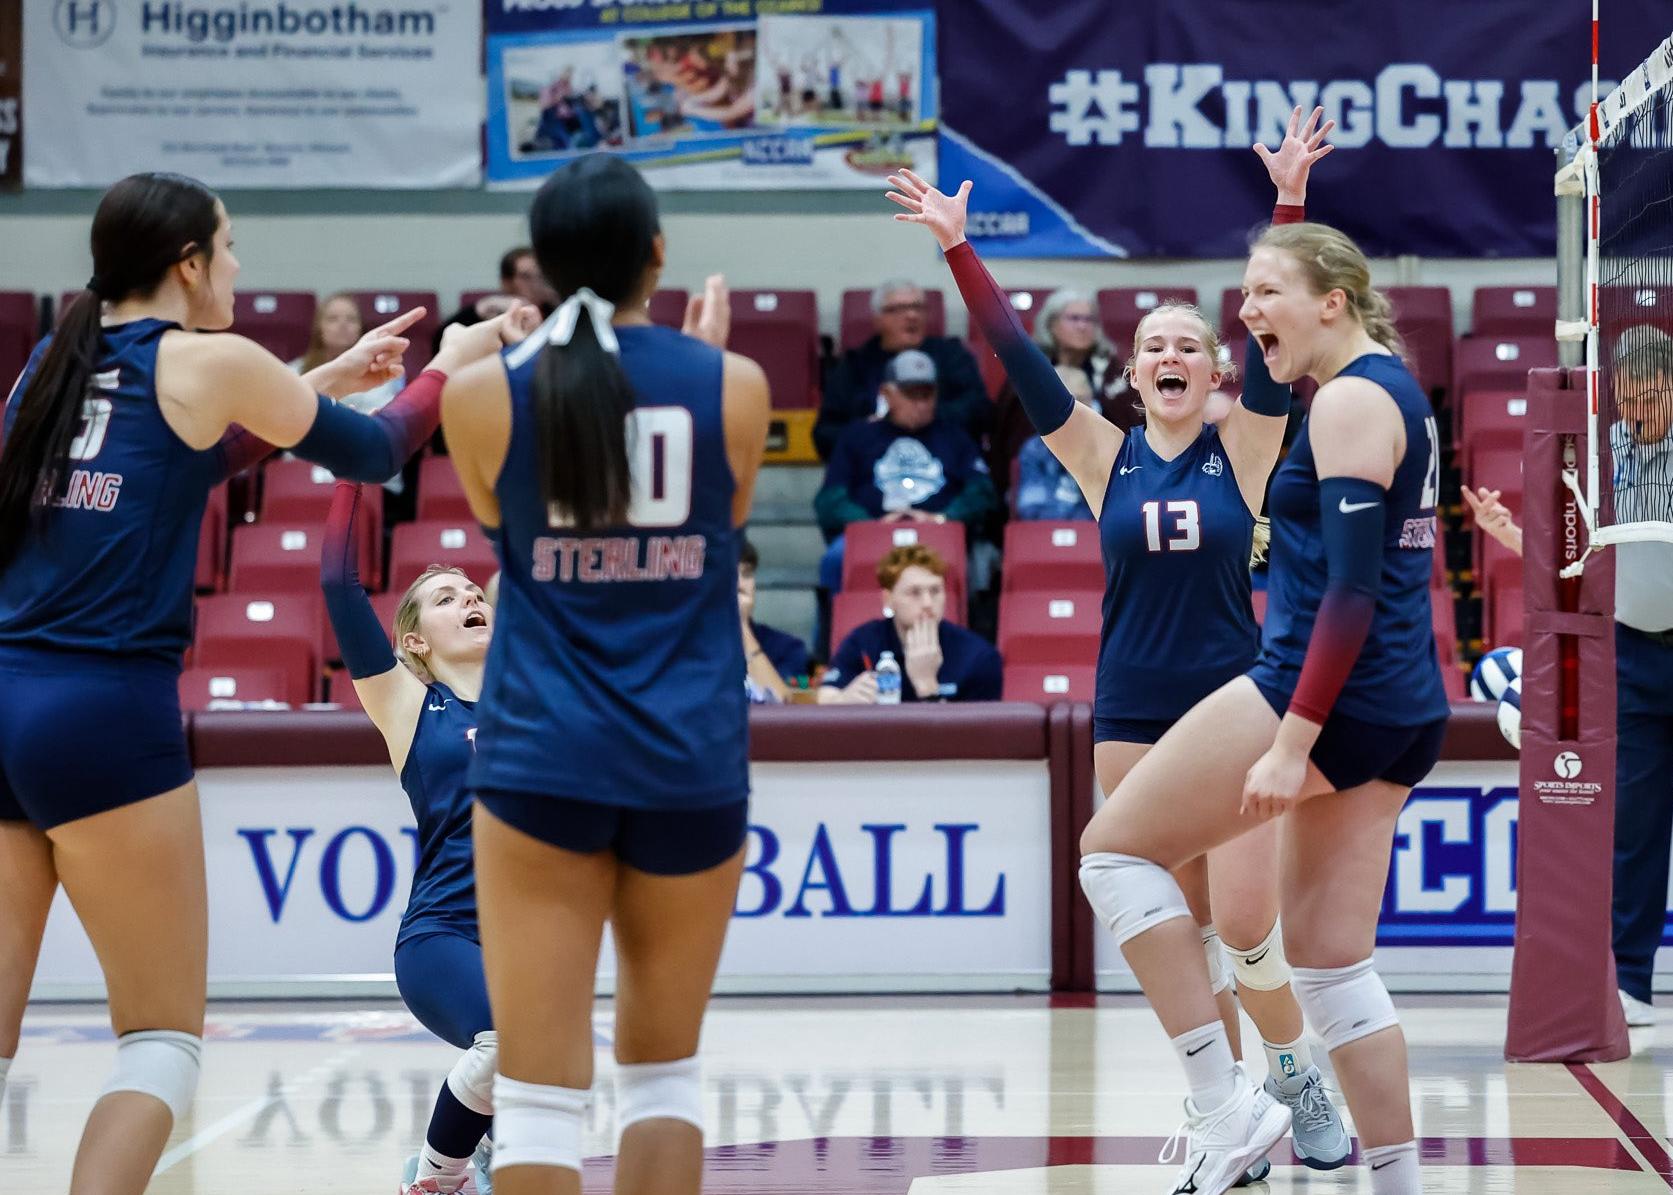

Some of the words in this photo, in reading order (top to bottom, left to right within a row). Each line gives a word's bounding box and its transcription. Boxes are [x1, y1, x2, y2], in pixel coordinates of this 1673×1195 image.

[141, 1, 435, 42] Higginbotham
[1141, 499, 1202, 552] 13
[531, 535, 706, 583] STERLING
